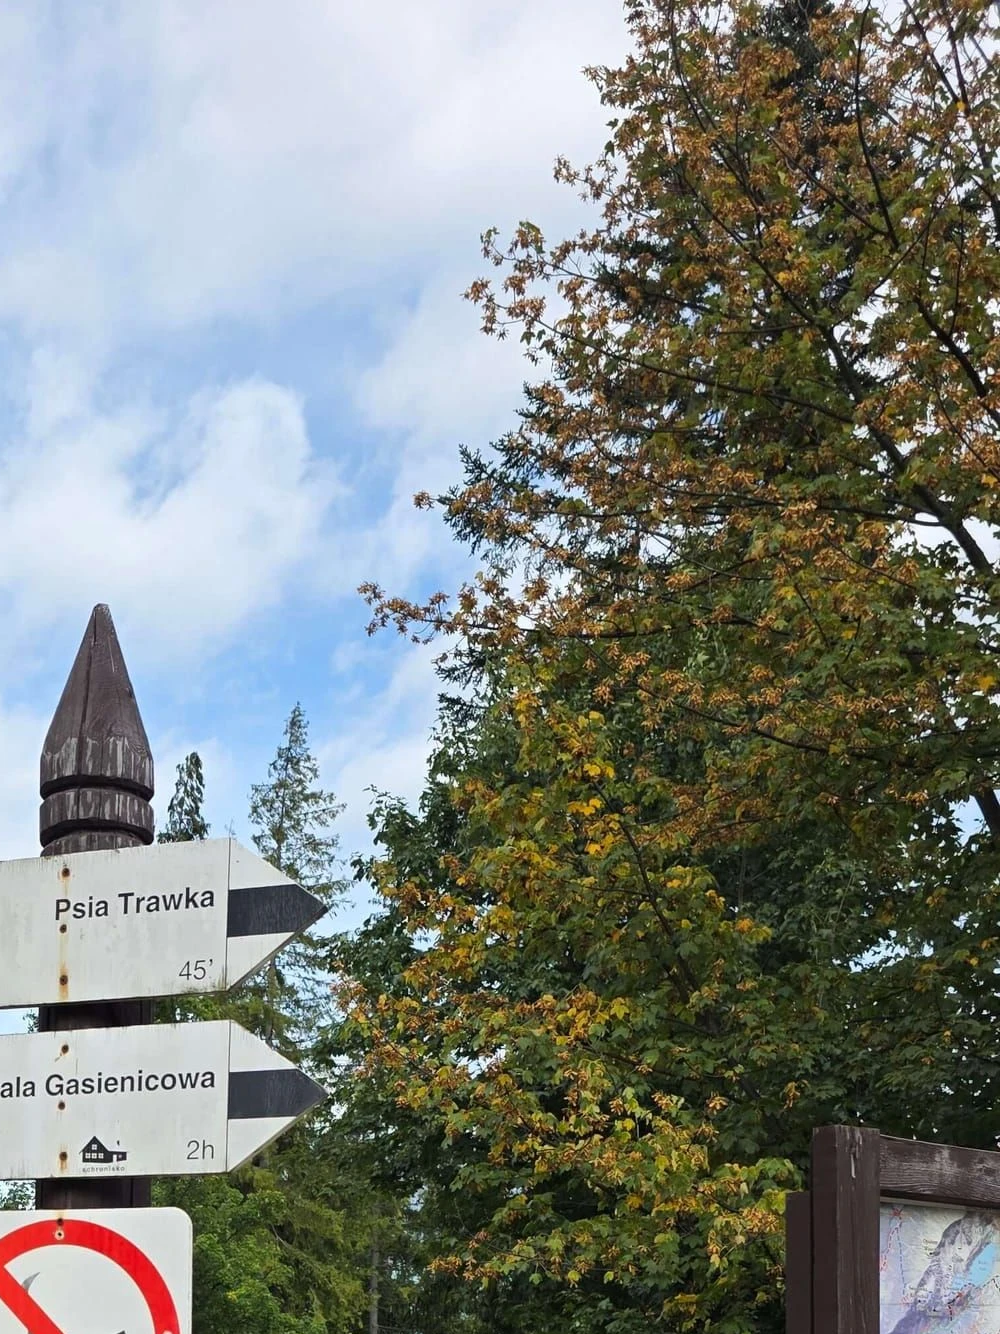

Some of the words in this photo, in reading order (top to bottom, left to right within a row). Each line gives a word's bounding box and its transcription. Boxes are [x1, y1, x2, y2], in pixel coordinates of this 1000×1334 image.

[55, 895, 109, 921] Psia
[117, 886, 215, 915] Trawka
[45, 1069, 215, 1097] Gasienicowa
[186, 1139, 214, 1160] 2h
[82, 1165, 126, 1173] schronisko
